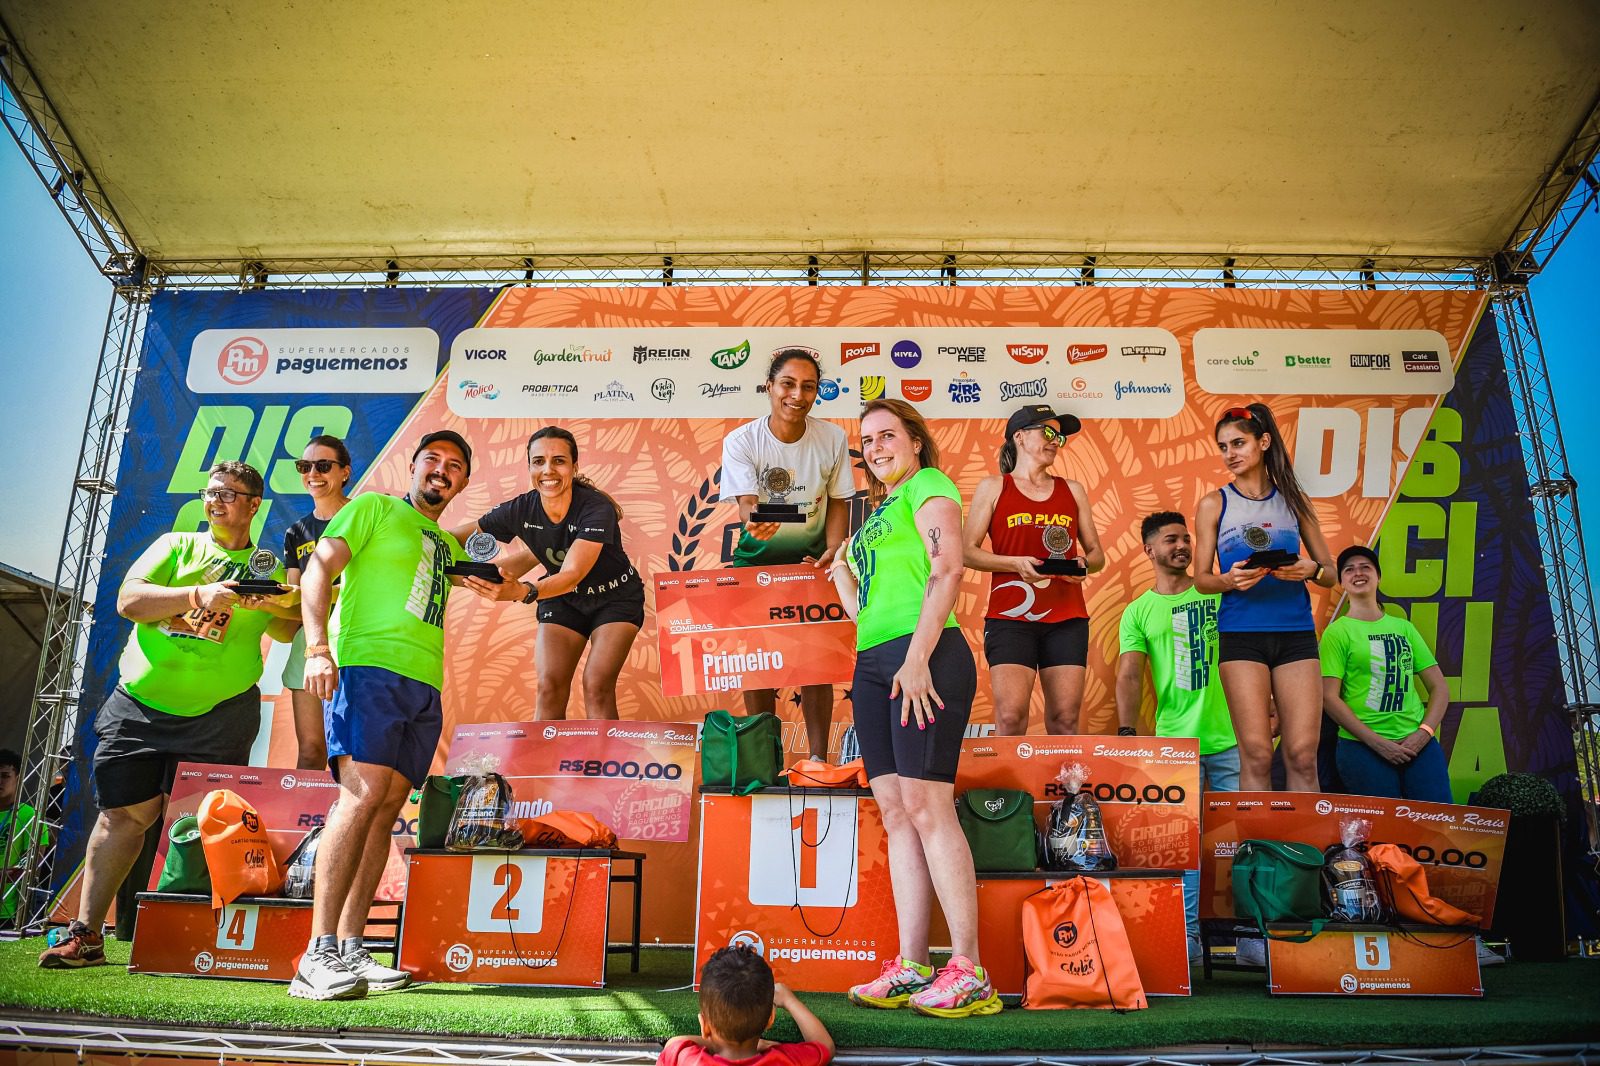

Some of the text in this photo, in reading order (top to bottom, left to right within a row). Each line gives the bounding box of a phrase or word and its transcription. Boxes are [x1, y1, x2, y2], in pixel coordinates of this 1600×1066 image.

[465, 349, 507, 361] VIGOR
[648, 348, 690, 358] REIGN
[715, 347, 747, 367] TANG
[845, 344, 876, 358] Royal
[1010, 345, 1045, 357] NISSIN
[1070, 346, 1106, 362] Bauducco
[1412, 353, 1428, 361] Café
[275, 357, 408, 374] paguemenos
[1232, 355, 1254, 366] club
[1297, 355, 1331, 365] better
[1405, 363, 1440, 372] Cassiano
[464, 384, 494, 400] Molico
[594, 390, 635, 401] PLATINA
[1000, 378, 1047, 401] SUCRILHOS
[1114, 380, 1172, 400] Johnson's
[166, 405, 353, 494] DIS
[1295, 407, 1462, 498] DIS
[1034, 513, 1073, 528] PLAST
[773, 574, 816, 583] paguemenos
[670, 618, 692, 626] VALE
[670, 623, 714, 632] COMPRAS
[702, 648, 784, 676] Primeiro
[704, 673, 744, 692] Lugar
[607, 728, 695, 741] Oitocentos Reais
[1035, 748, 1083, 756] paguemenos
[1093, 744, 1197, 759] Seiscentos Reais
[559, 760, 682, 780] R$800,00
[629, 793, 682, 814] CIRCUITO
[1334, 806, 1385, 815] paguemenos
[1395, 805, 1505, 828] Dezentos Reais
[630, 820, 681, 838] 2023
[1130, 818, 1189, 842] CIRCUITO
[791, 807, 819, 889] 1
[1134, 847, 1190, 869] 2023
[490, 863, 523, 920] 2
[226, 908, 247, 946] 4
[769, 937, 877, 947] SUPERMERCADOS
[769, 946, 877, 964] paguemenos
[1364, 936, 1380, 967] 5
[215, 961, 269, 971] paguemenos
[476, 956, 558, 969] paguemenos
[1359, 981, 1411, 990] paguemenos
